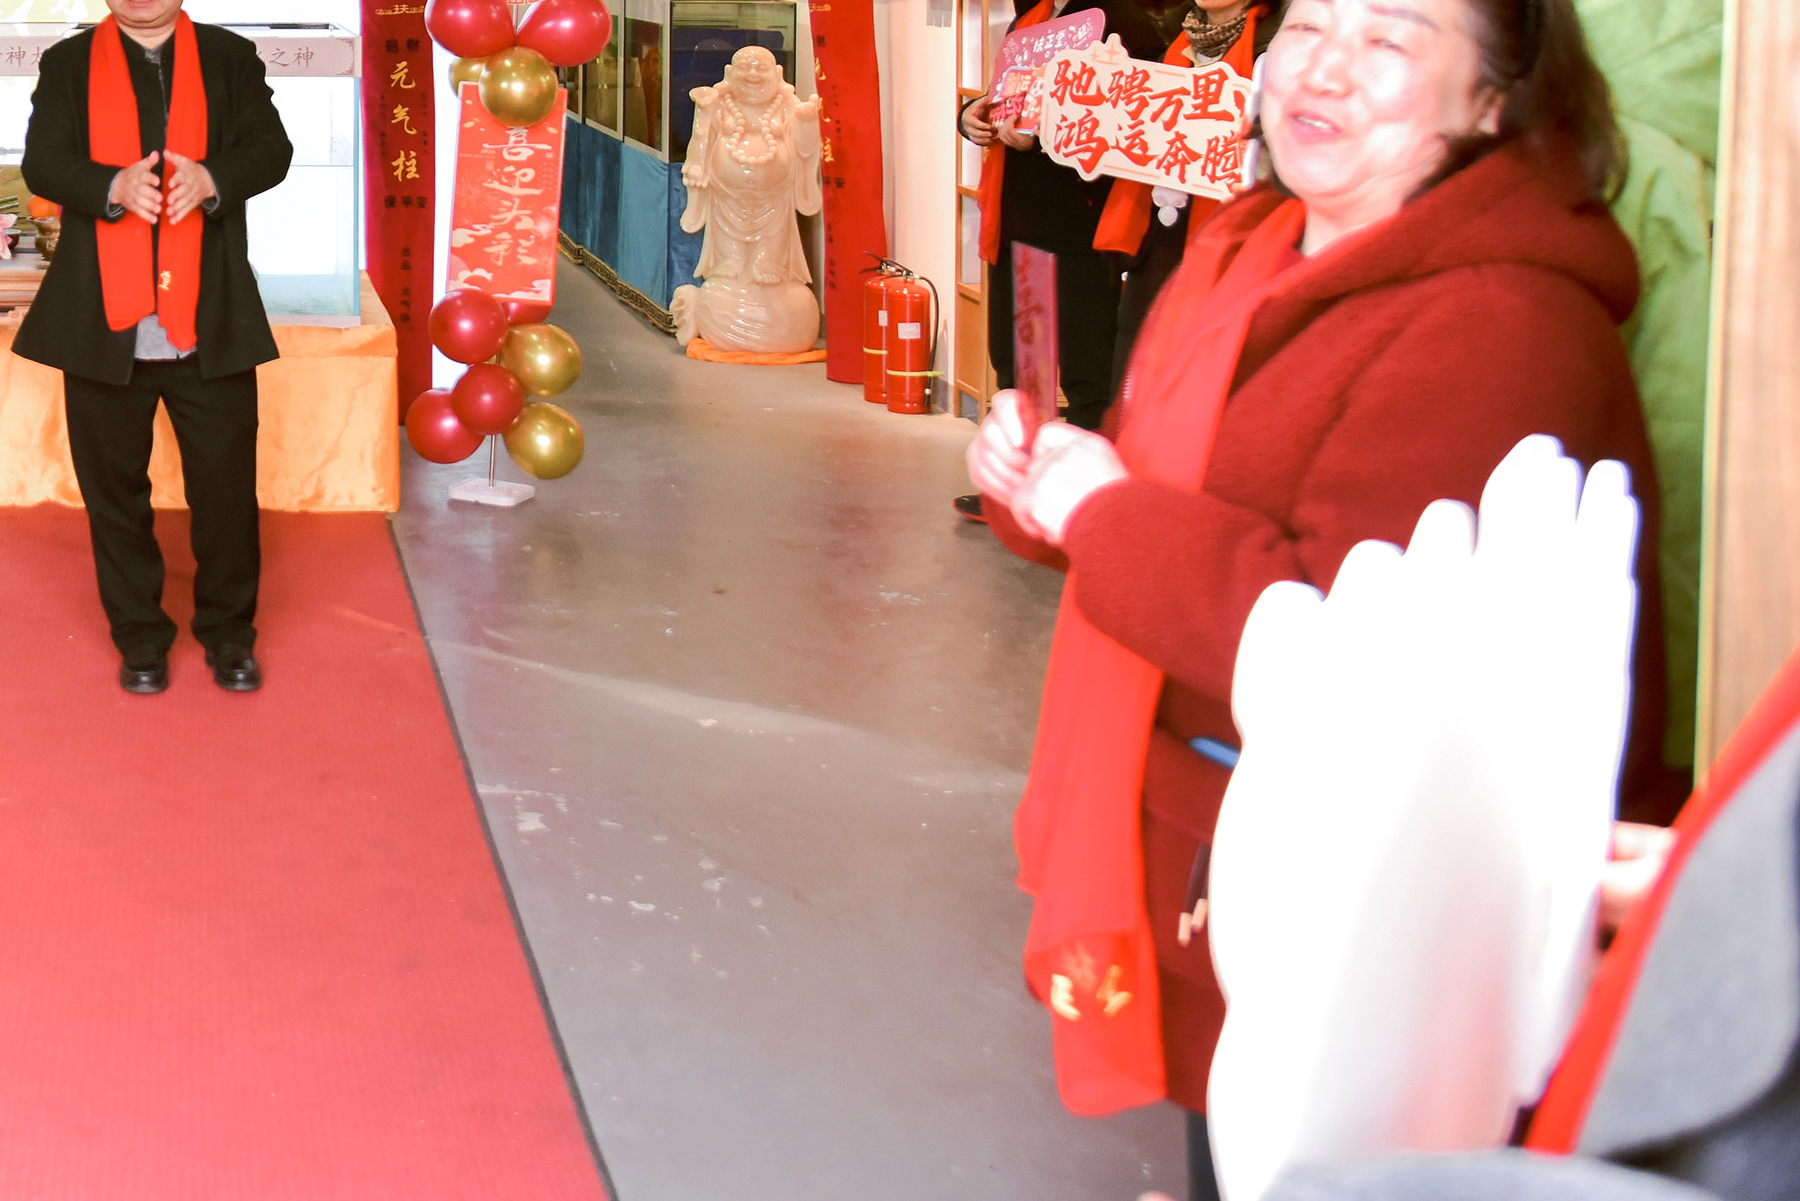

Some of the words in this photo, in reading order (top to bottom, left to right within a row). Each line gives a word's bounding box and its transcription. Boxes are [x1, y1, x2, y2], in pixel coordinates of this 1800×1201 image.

[390, 60, 420, 182] 元气柱
[1049, 60, 1235, 132] 驰骋万里
[482, 127, 552, 266] 喜迎头彩
